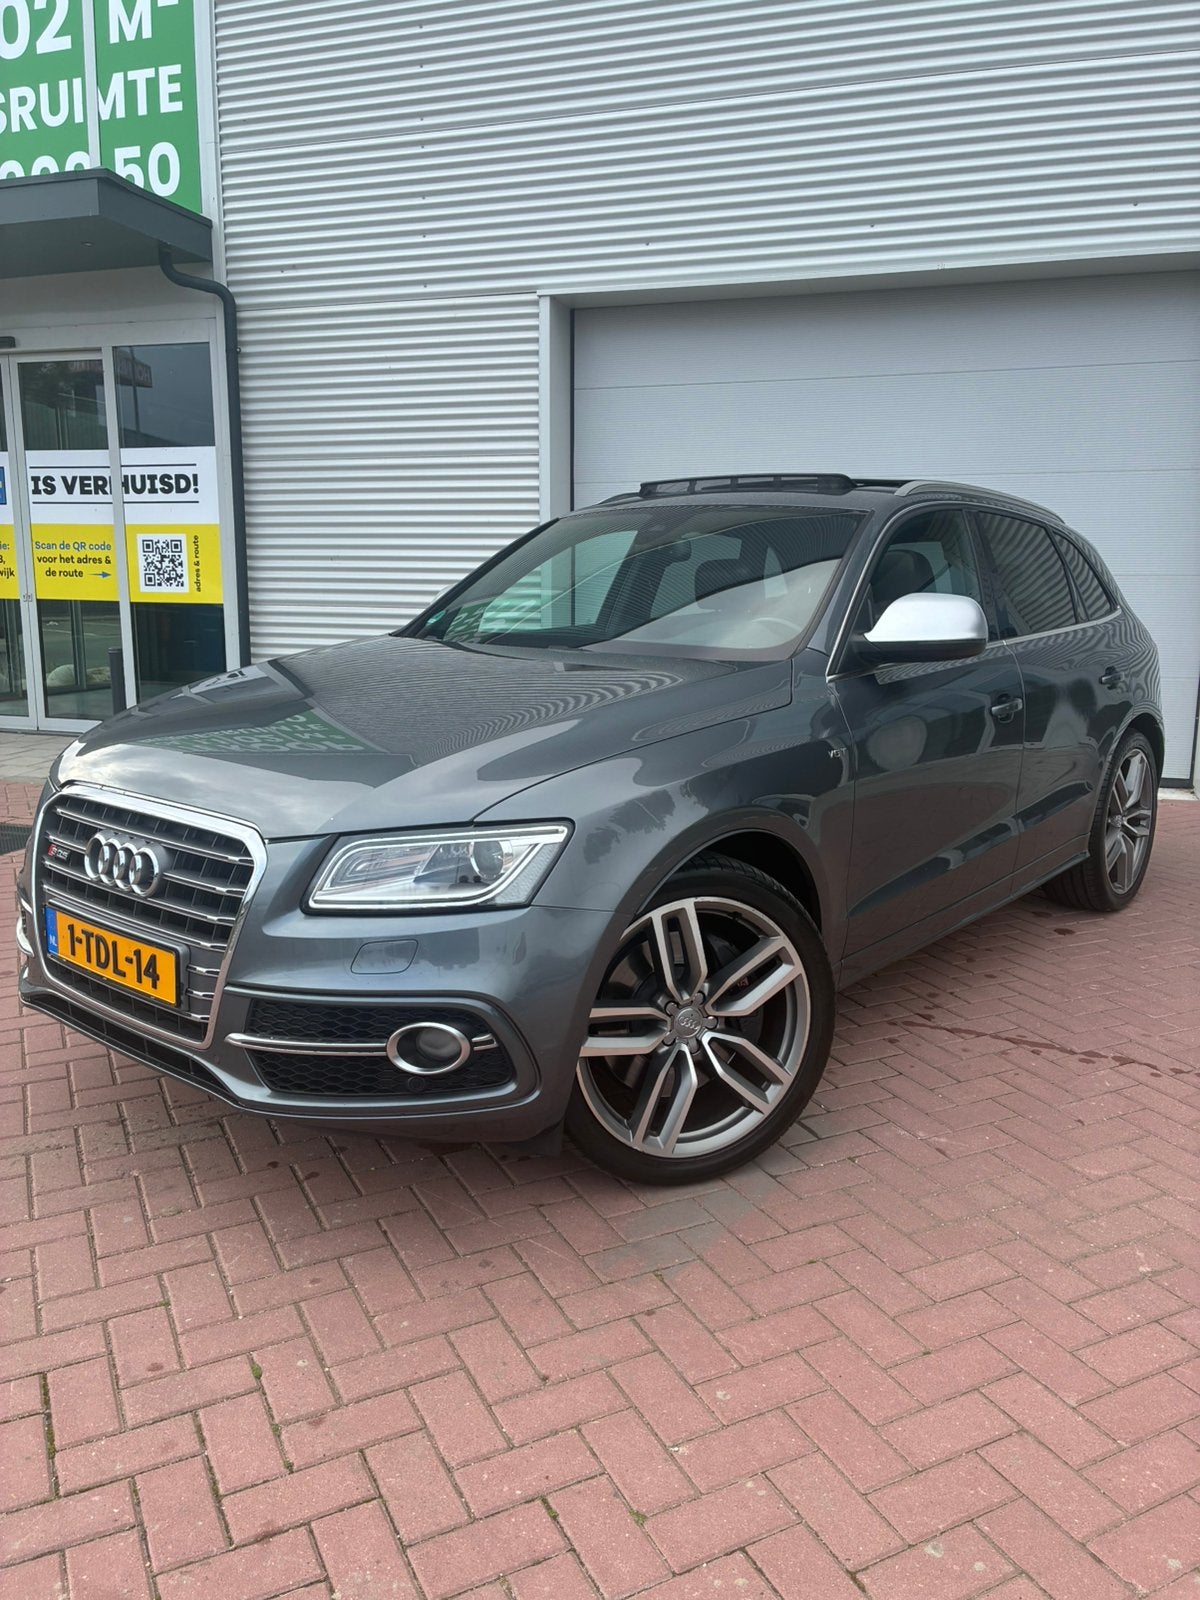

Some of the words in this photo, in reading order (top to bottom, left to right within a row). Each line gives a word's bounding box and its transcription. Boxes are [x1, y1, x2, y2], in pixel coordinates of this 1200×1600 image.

[108, 0, 179, 44] M
[0, 64, 183, 135] RUIMTE
[31, 475, 57, 495] IS
[60, 473, 200, 496] VERHUISD!
[35, 541, 57, 550] Scan
[59, 540, 71, 550] de
[72, 541, 87, 551] QR
[88, 540, 112, 551] code
[37, 555, 57, 563] voor
[59, 554, 75, 564] het
[76, 554, 103, 564] adres
[105, 555, 112, 565] &
[45, 567, 57, 577] de
[58, 568, 84, 578] route
[67, 923, 160, 990] 1-TDL-14
